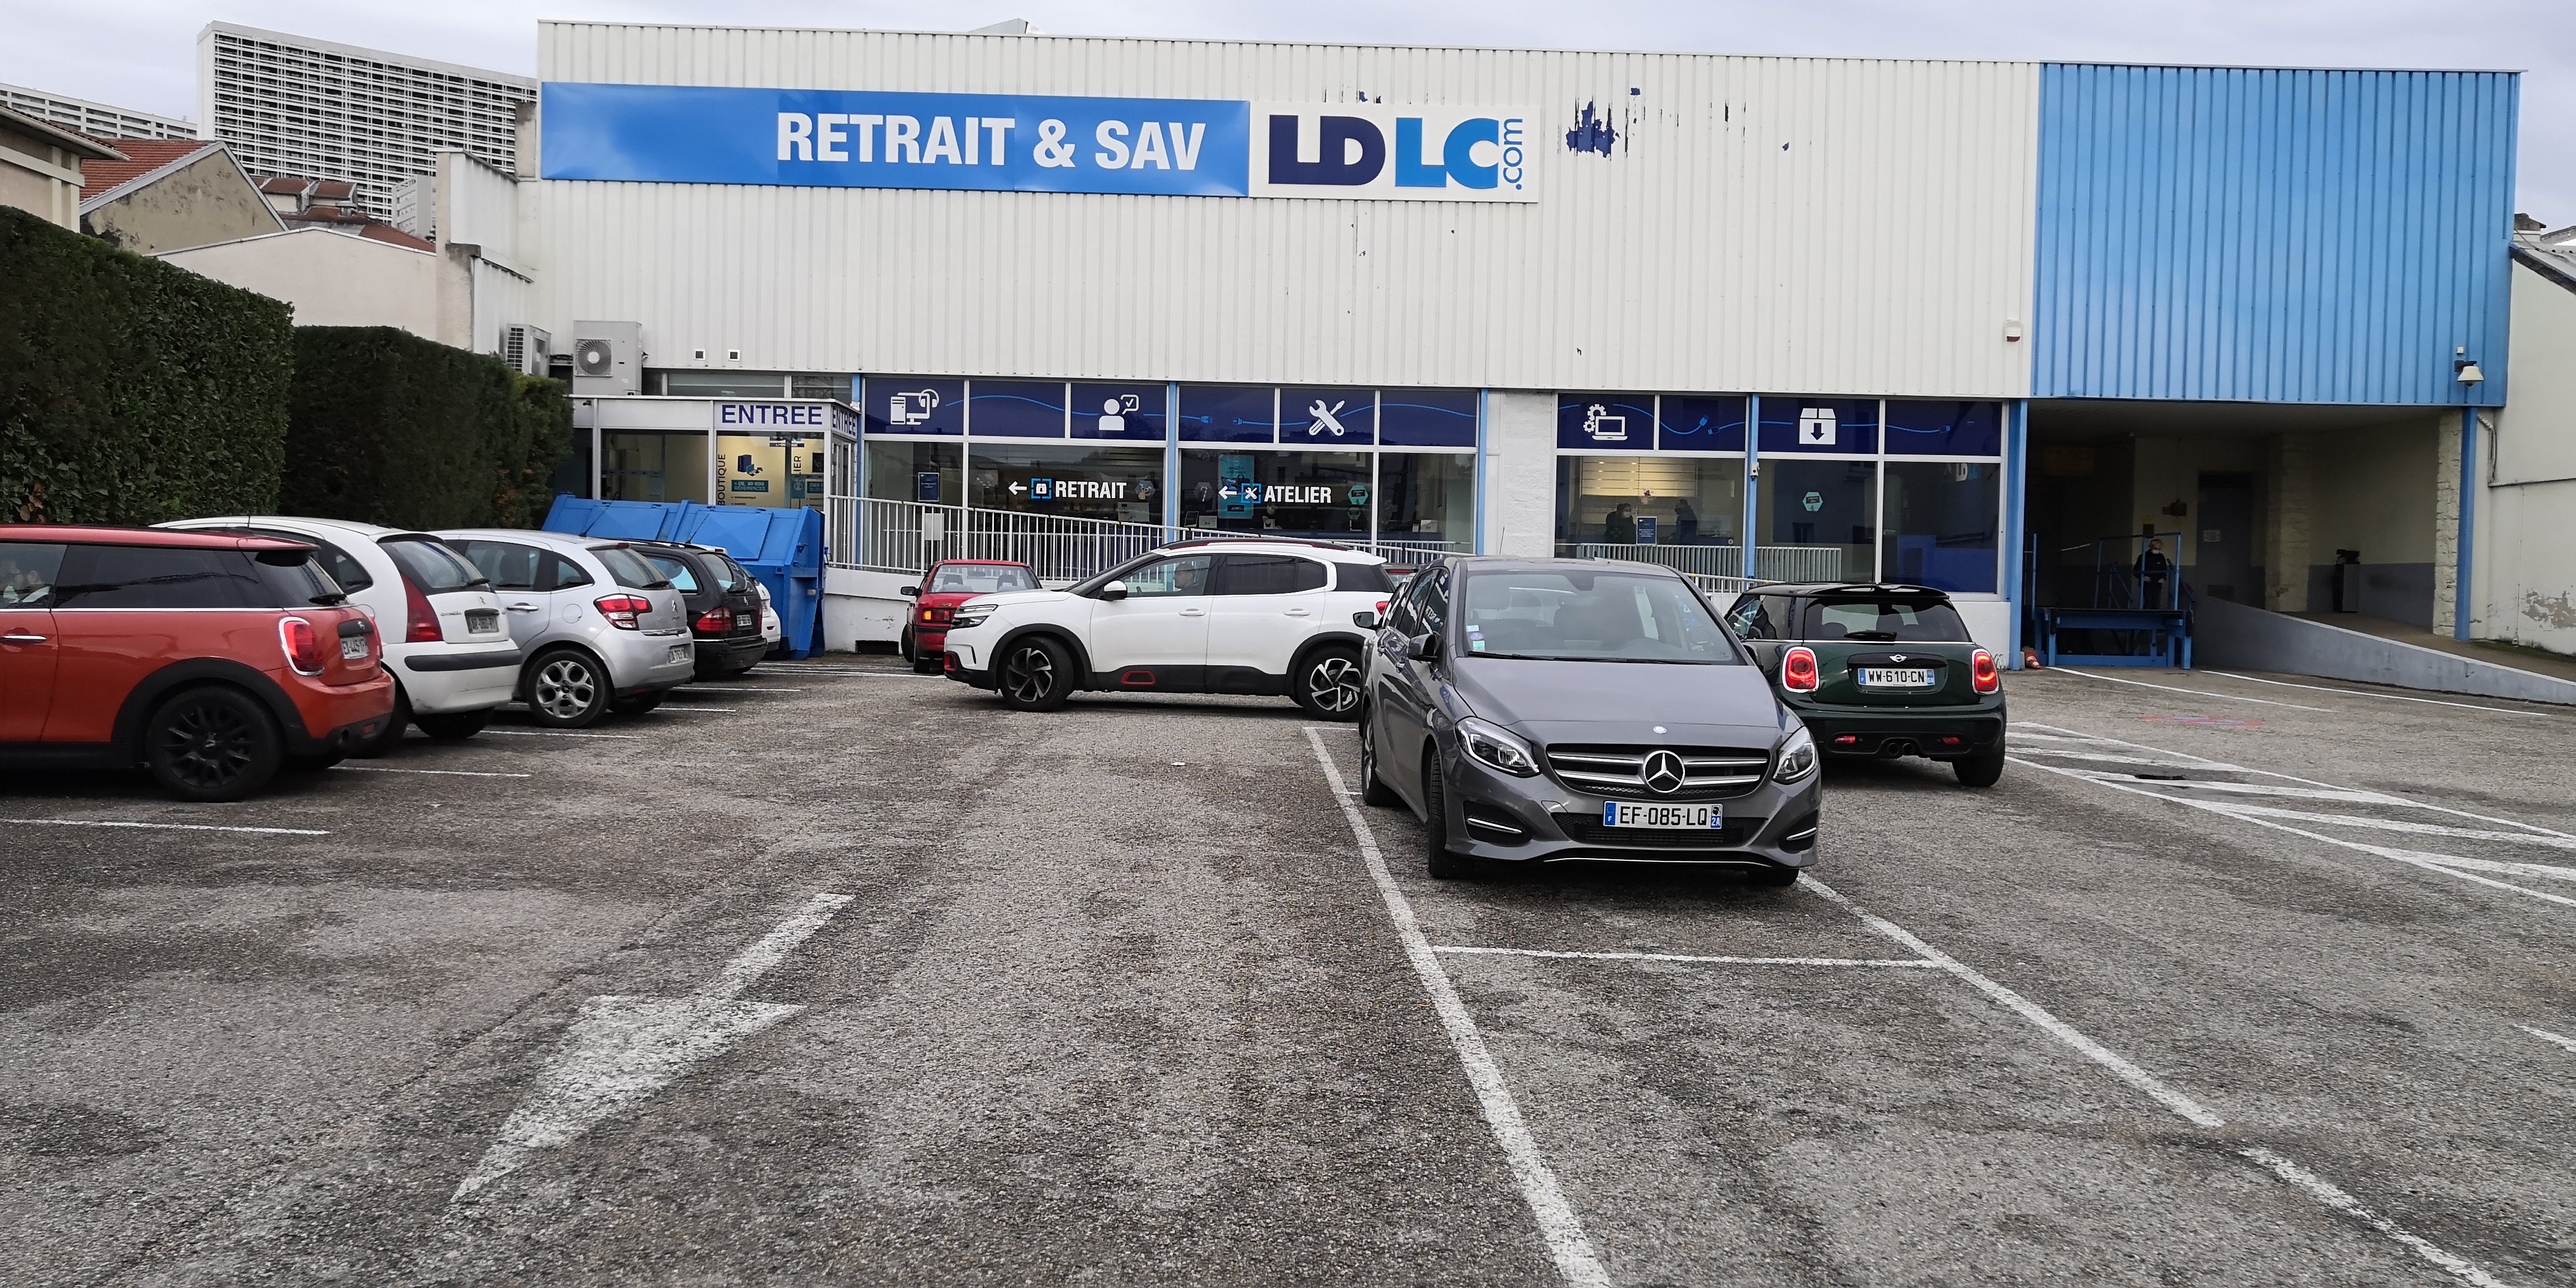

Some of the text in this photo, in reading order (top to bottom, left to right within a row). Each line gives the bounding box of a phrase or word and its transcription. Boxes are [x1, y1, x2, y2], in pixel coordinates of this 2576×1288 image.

[778, 112, 1206, 171] RETRAIT & SAV
[1268, 114, 1499, 190] LDLC
[722, 404, 823, 425] ENTREE
[832, 406, 856, 436] ENTREE
[717, 454, 727, 506] BOUTIQUE
[1055, 480, 1127, 499] RETRAIT
[1263, 485, 1332, 504] ATELIER
[1868, 670, 1925, 683] WW-610-CN
[1620, 806, 1707, 826] EF-085-LQ
[1711, 817, 1721, 827] 2A
